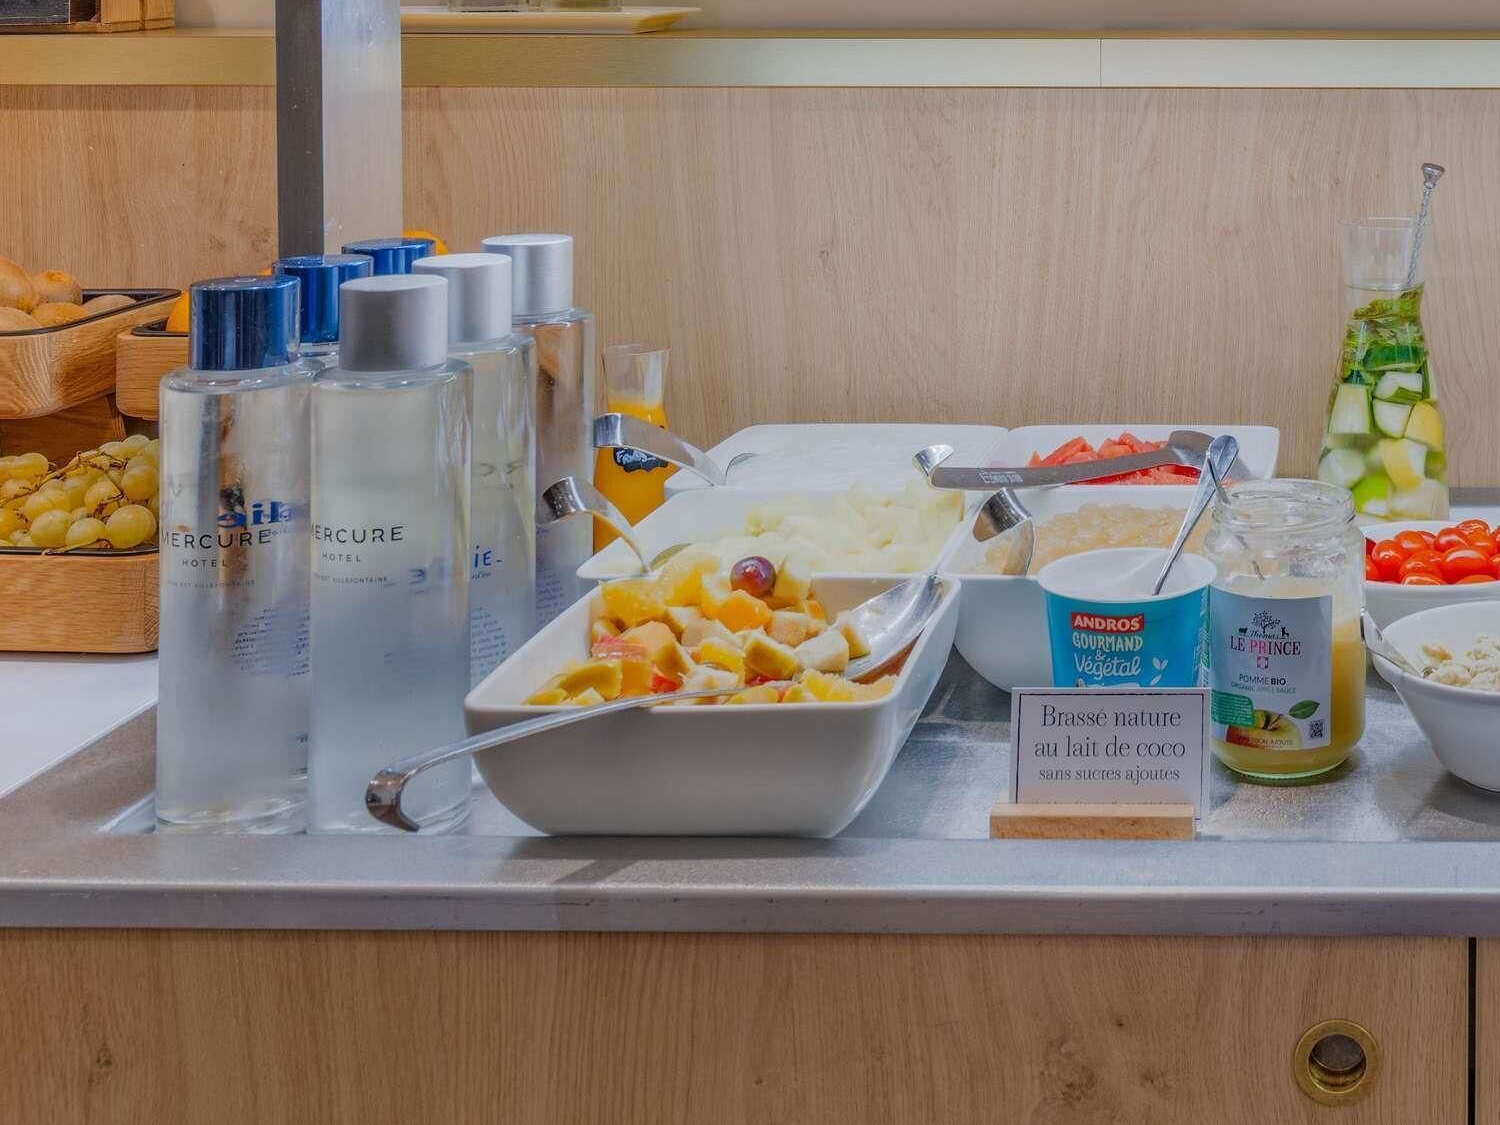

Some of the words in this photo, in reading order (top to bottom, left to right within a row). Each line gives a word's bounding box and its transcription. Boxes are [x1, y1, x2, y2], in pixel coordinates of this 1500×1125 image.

[160, 528, 272, 549] MERCURE
[182, 558, 228, 569] HOTEL
[322, 551, 362, 563] HOTEL
[1073, 614, 1142, 631] ANDROS
[1072, 631, 1144, 652] GOURMAND
[1230, 635, 1246, 652] LE
[1249, 639, 1302, 656] PRINCE
[1095, 649, 1107, 661] &
[1073, 652, 1142, 681] Végétal
[1270, 677, 1287, 686] BIO
[1041, 704, 1107, 727] Brassé
[1114, 708, 1182, 727] nature
[1034, 741, 1058, 757] au
[1066, 735, 1099, 757] lait
[1105, 735, 1130, 757] de
[1136, 741, 1186, 757] coco
[1039, 768, 1071, 780] sans
[1075, 768, 1122, 780] sucres
